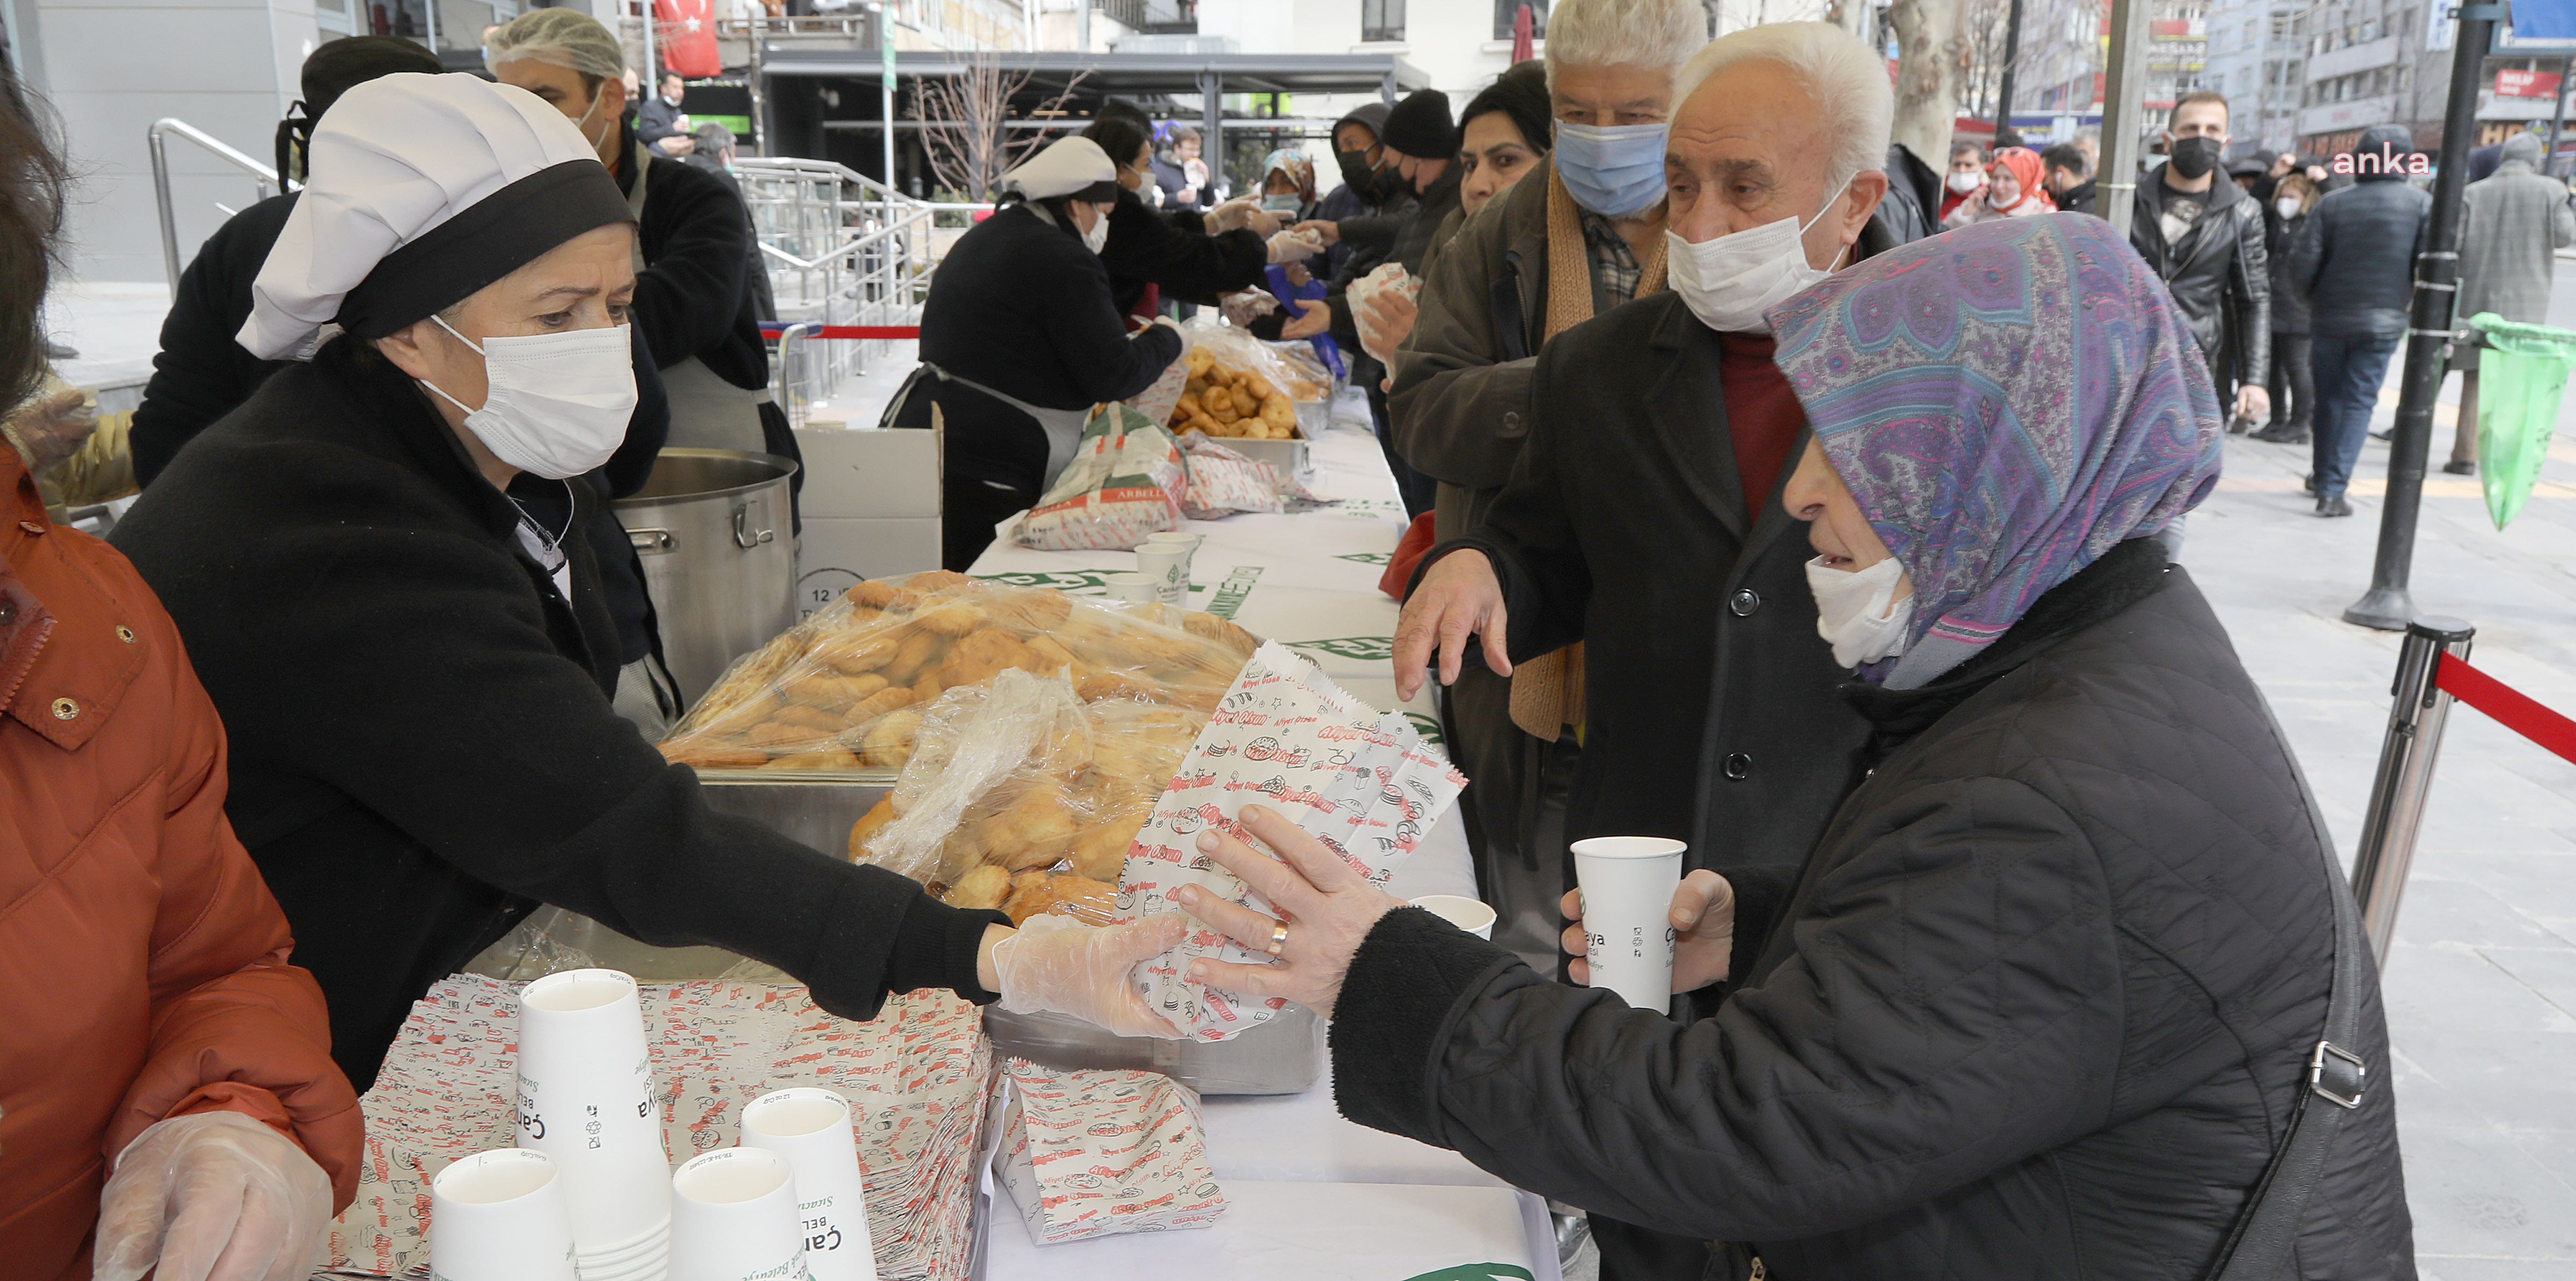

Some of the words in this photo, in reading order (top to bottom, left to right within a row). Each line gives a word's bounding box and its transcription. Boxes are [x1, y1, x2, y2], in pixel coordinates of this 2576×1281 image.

[812, 590, 829, 602] 12
[1242, 680, 1260, 689] Afiyet
[1262, 676, 1280, 685] Olsun
[1238, 710, 1268, 726] Olsun
[1274, 717, 1294, 727] Afiyet
[1318, 725, 1362, 742] Afiyet
[763, 1097, 774, 1105] Cup
[1050, 1119, 1083, 1130] Olsun
[1044, 1176, 1064, 1184] Afiyet
